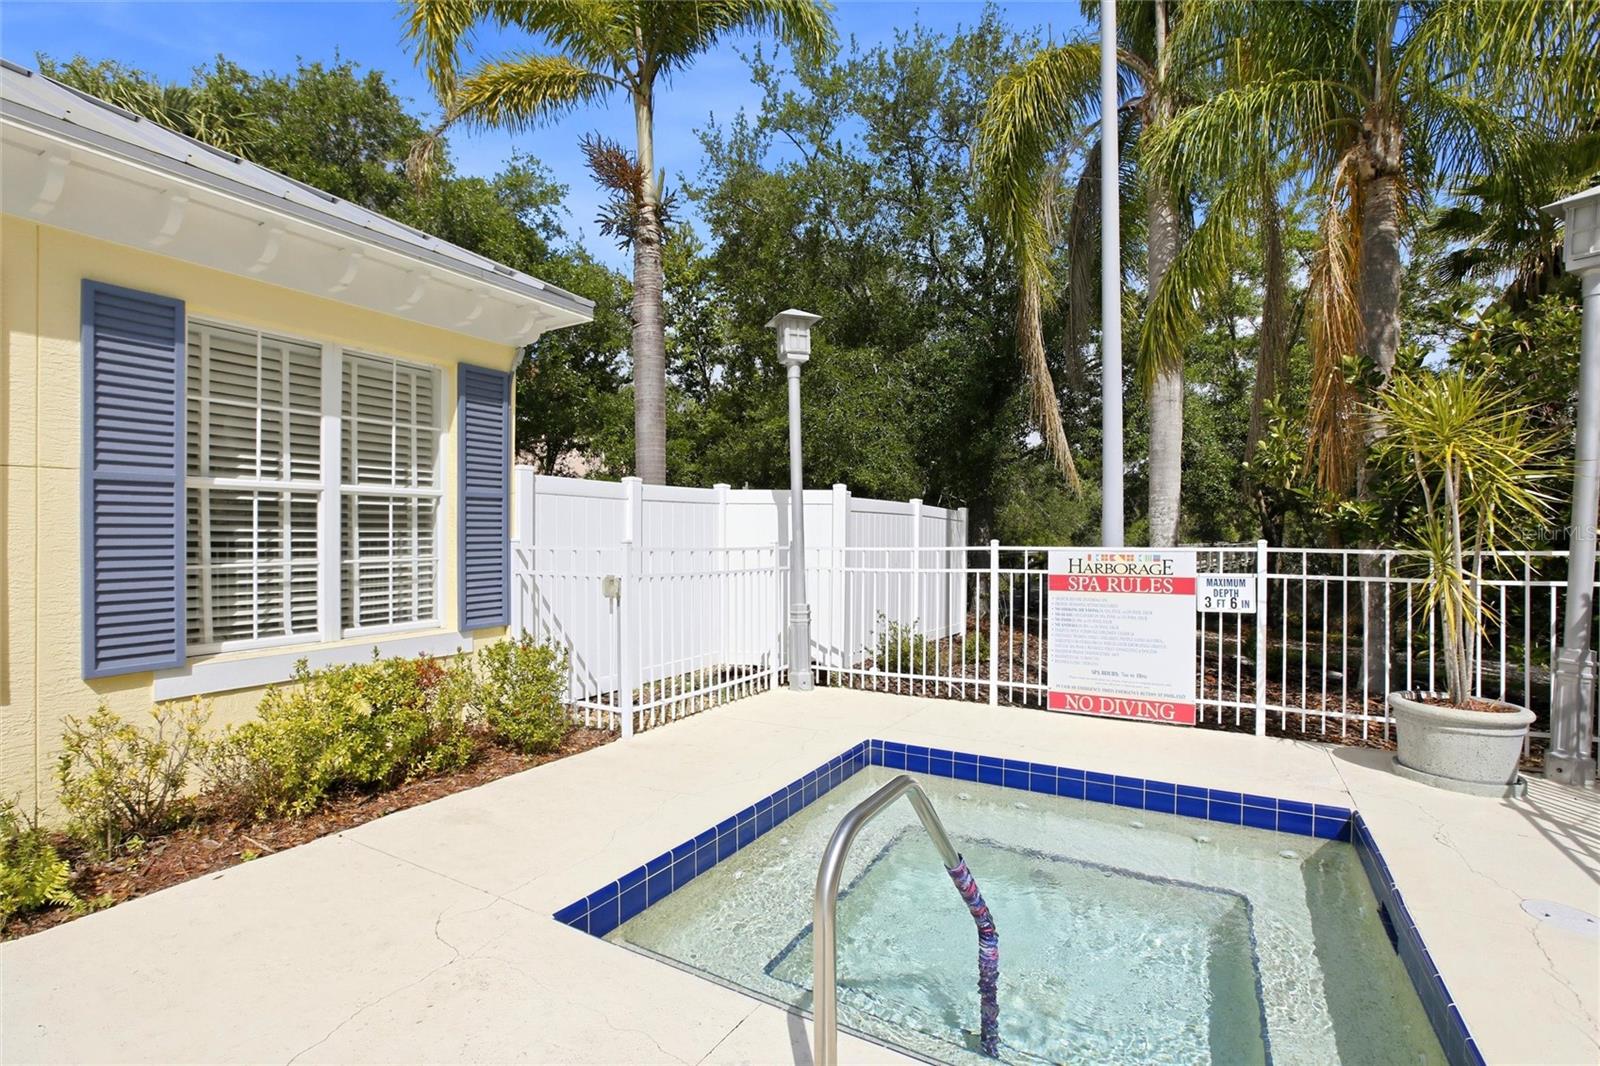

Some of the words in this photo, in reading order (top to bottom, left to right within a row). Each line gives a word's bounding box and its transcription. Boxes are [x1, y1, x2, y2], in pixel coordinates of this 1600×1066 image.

[1068, 577, 1100, 592] SPA
[1106, 577, 1174, 594] RULES
[1206, 578, 1246, 587] MAXIMUM
[1213, 588, 1239, 598] DEPTH
[1204, 596, 1212, 608] 3
[1216, 599, 1226, 608] FT
[1230, 597, 1238, 609] 6
[1241, 600, 1250, 609] IN
[1065, 694, 1093, 712] NO
[1099, 696, 1176, 720] DIVING
